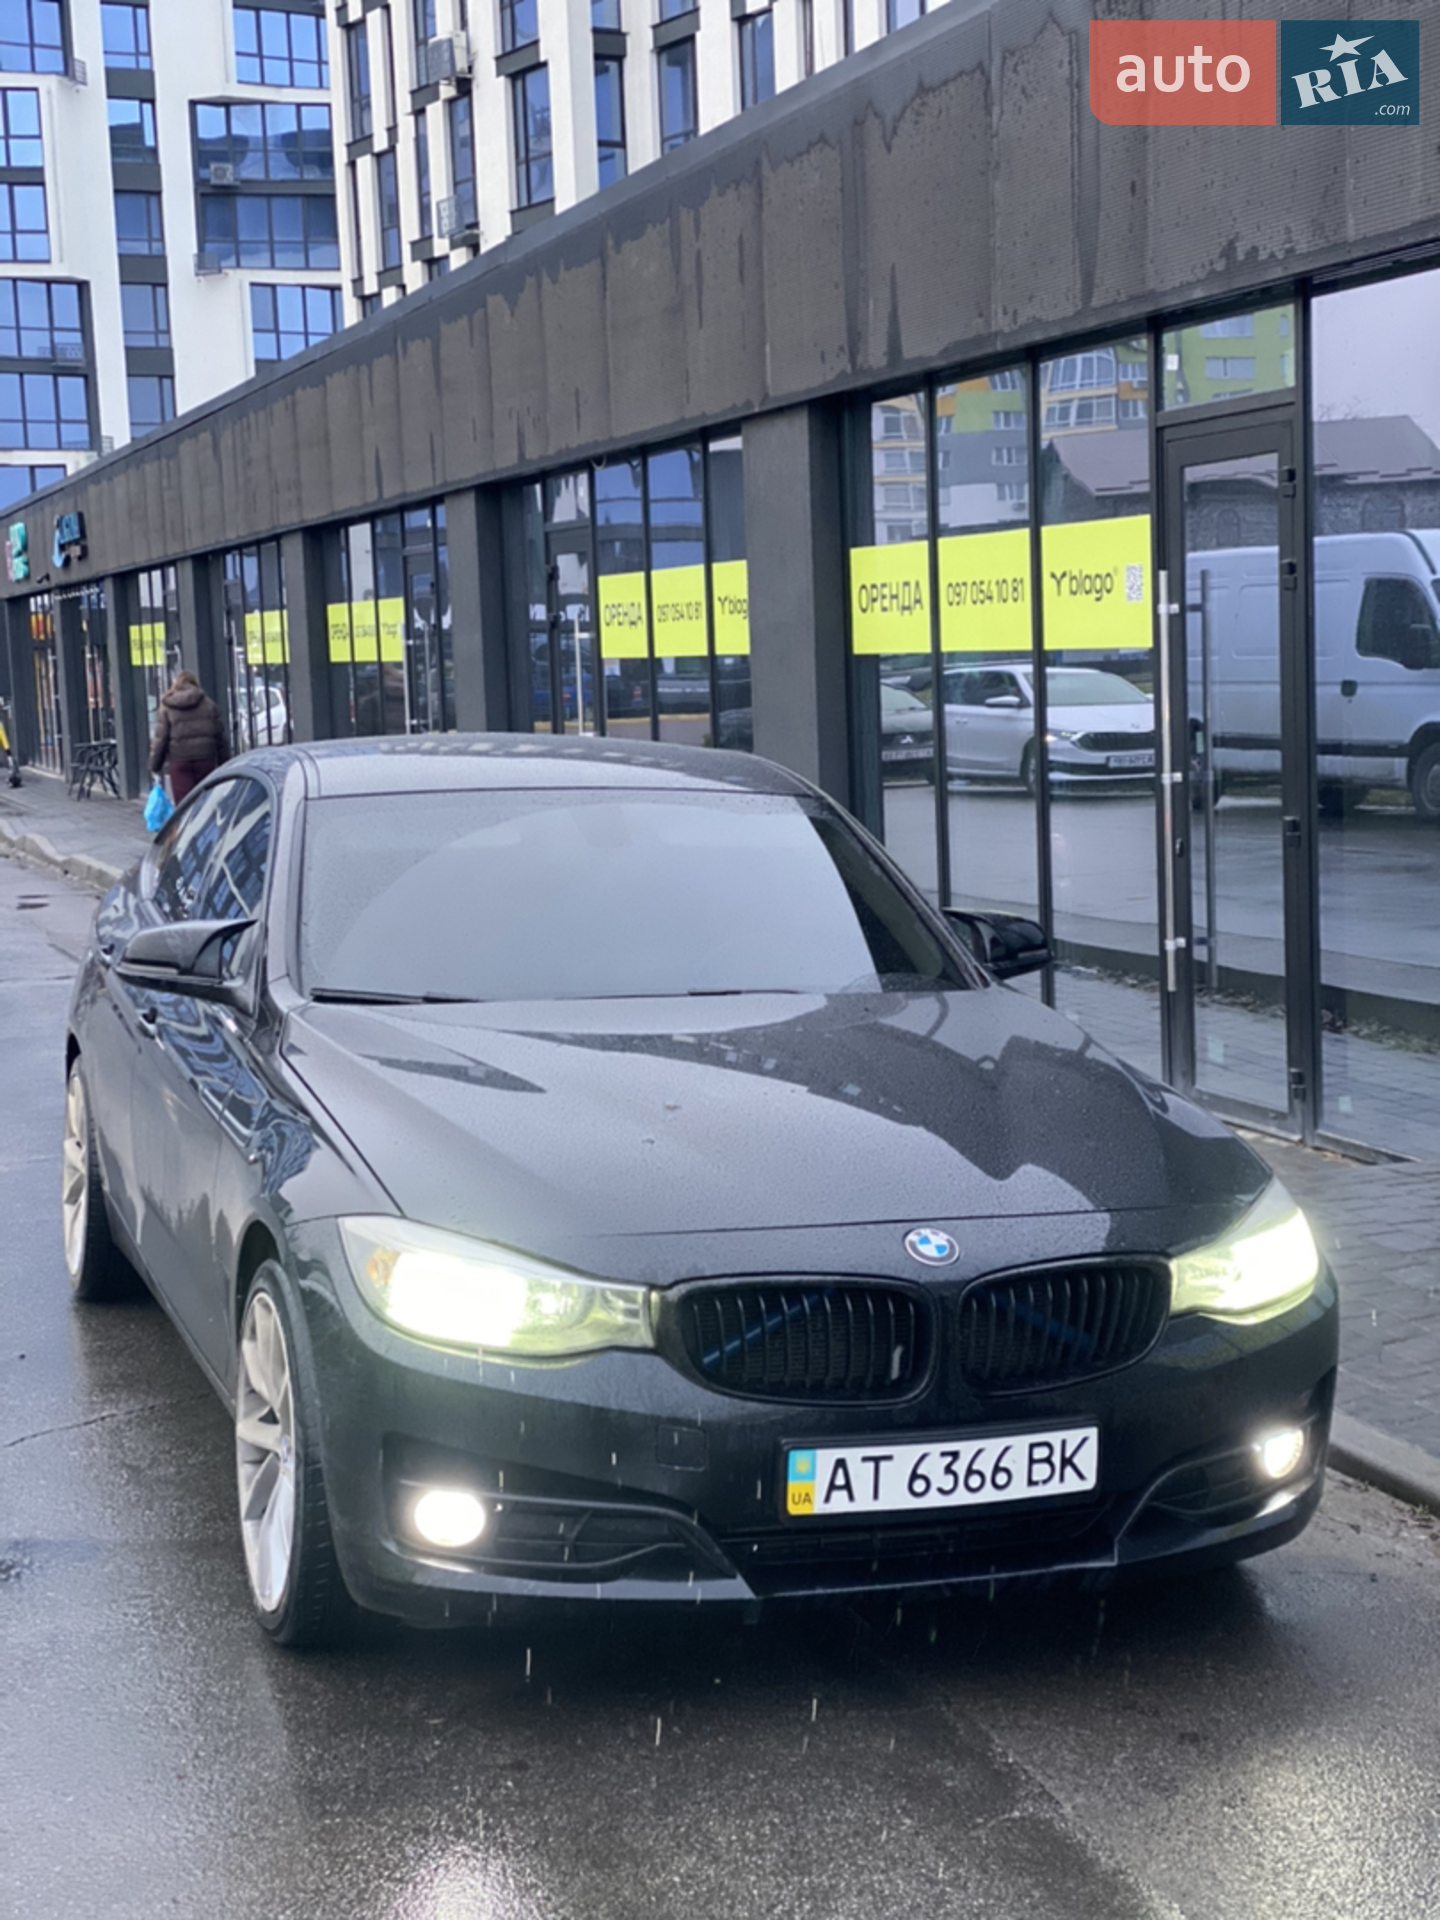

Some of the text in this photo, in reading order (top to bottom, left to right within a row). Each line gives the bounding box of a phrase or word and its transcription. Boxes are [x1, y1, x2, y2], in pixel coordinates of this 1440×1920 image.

[858, 581, 924, 616] ОРЕНДА
[946, 577, 1025, 606] 097 054 10 81
[823, 1436, 1090, 1504] AT 6366 BK
[791, 1493, 812, 1505] UA
